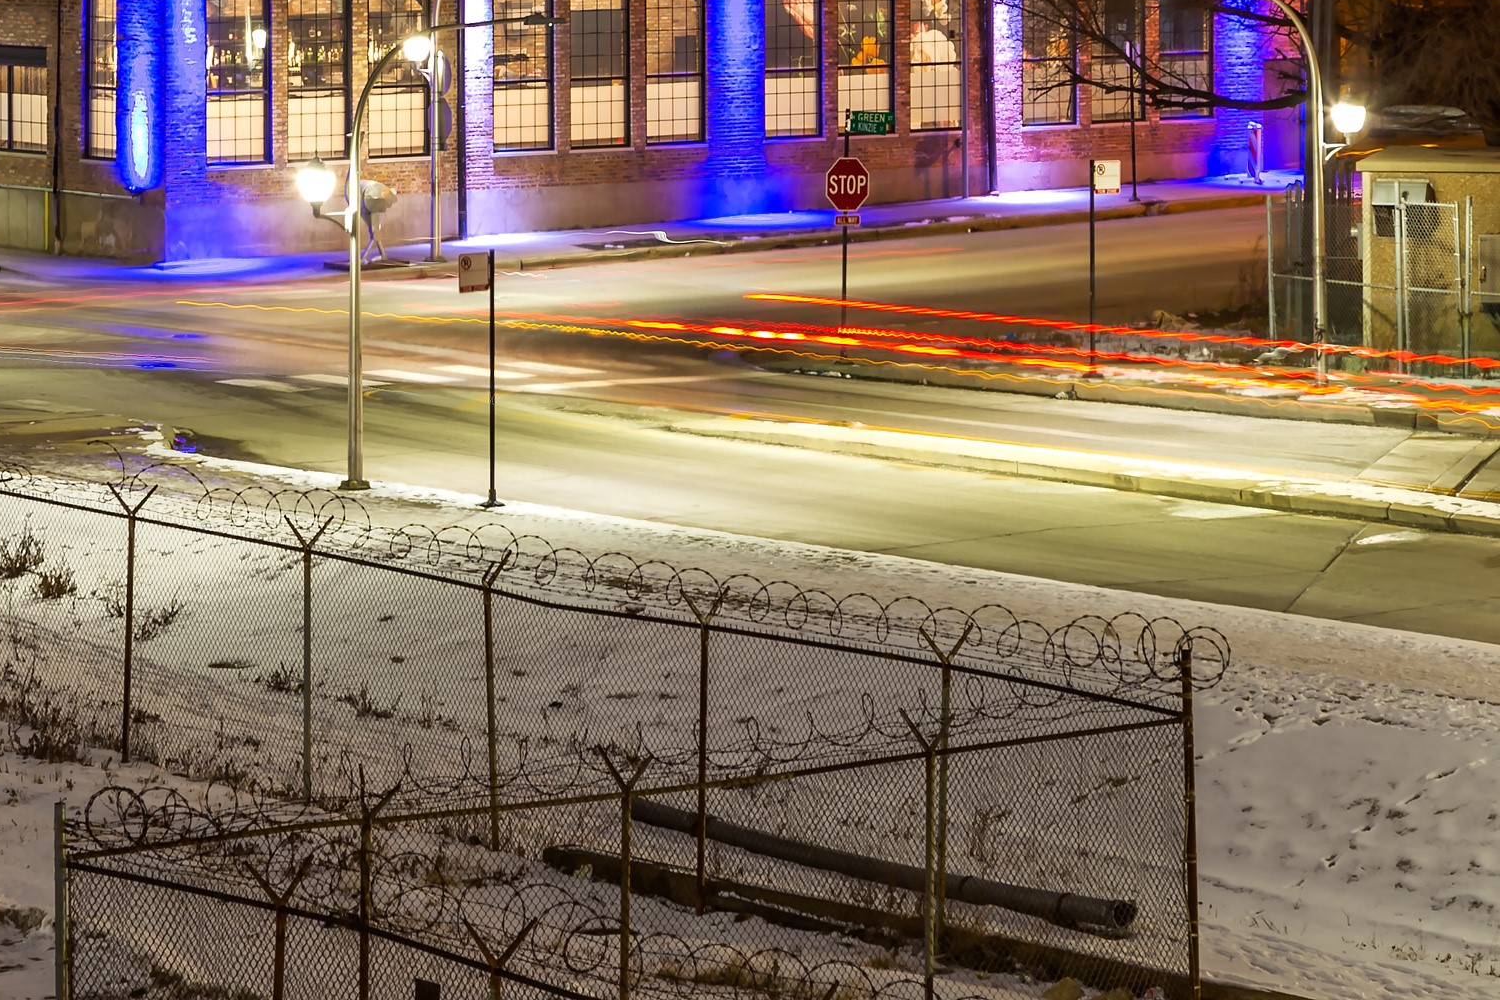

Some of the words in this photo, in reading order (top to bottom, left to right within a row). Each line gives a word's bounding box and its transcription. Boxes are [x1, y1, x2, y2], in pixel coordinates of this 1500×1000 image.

[858, 113, 886, 123] GREEN
[858, 122, 878, 133] KINZIE
[829, 175, 867, 195] STOP
